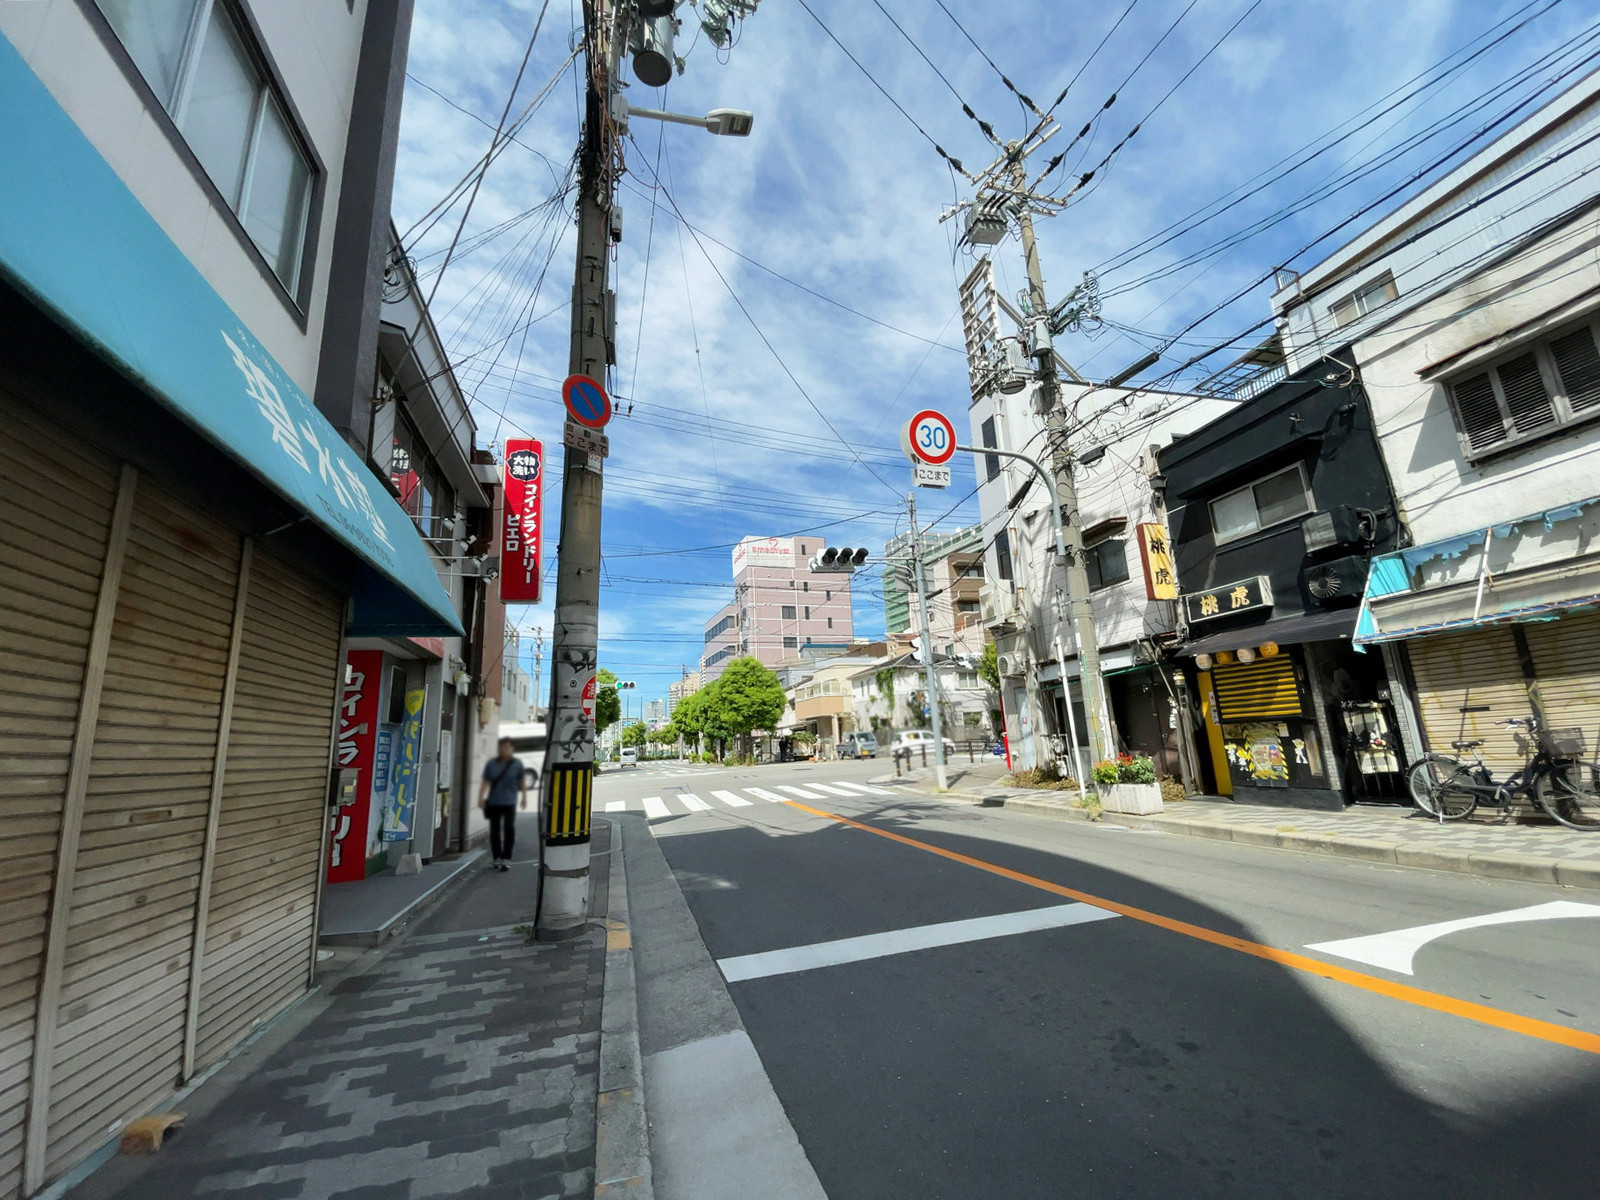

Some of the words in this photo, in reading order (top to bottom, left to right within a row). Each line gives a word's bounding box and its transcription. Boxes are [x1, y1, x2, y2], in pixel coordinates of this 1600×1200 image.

[565, 432, 608, 456] ここまで
[920, 424, 946, 450] 30
[512, 465, 535, 476] 洗い
[513, 455, 535, 466] 大物
[919, 469, 950, 482] ここまで
[506, 513, 521, 552] ピエロ
[522, 484, 538, 584] コインランドリー
[1150, 536, 1171, 586] 桃虎
[1201, 586, 1250, 616] 桃虎
